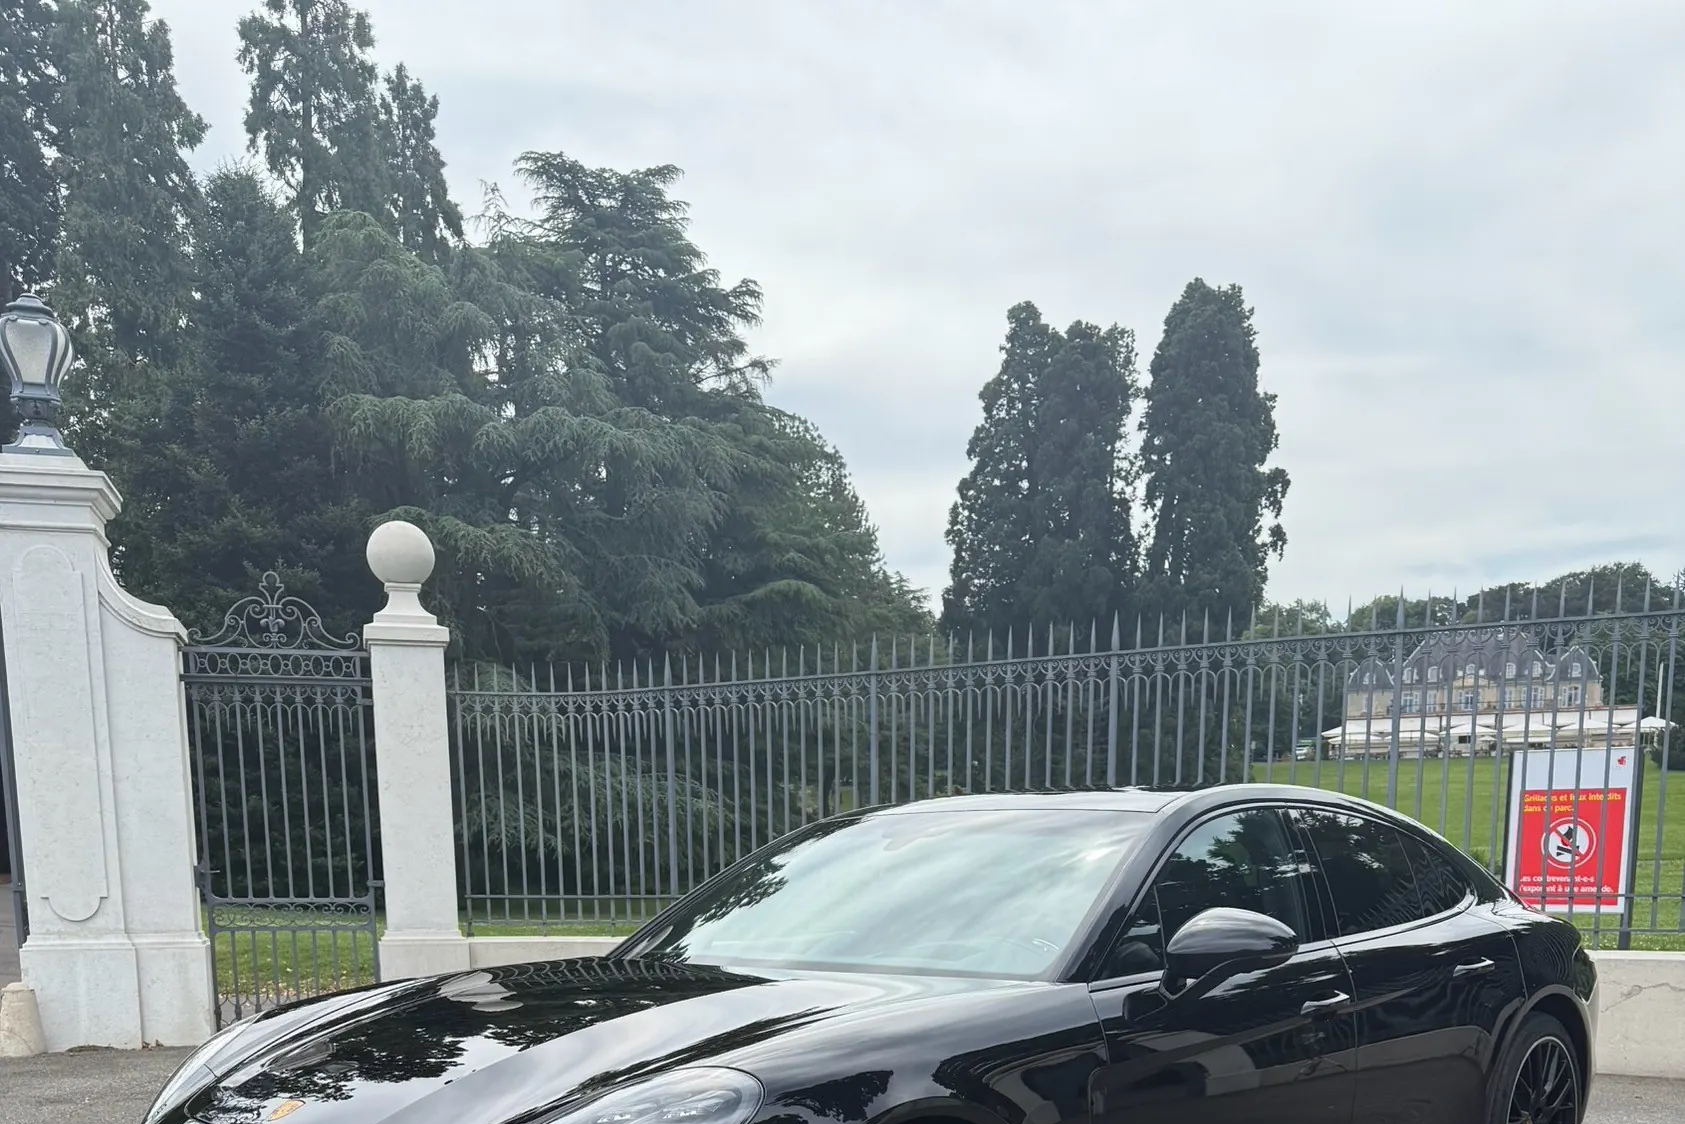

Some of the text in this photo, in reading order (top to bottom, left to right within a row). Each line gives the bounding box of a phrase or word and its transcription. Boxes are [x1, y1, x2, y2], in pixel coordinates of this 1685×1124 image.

[1559, 793, 1568, 801] et
[1588, 792, 1621, 801] intedits
[1580, 884, 1614, 893] amede.
